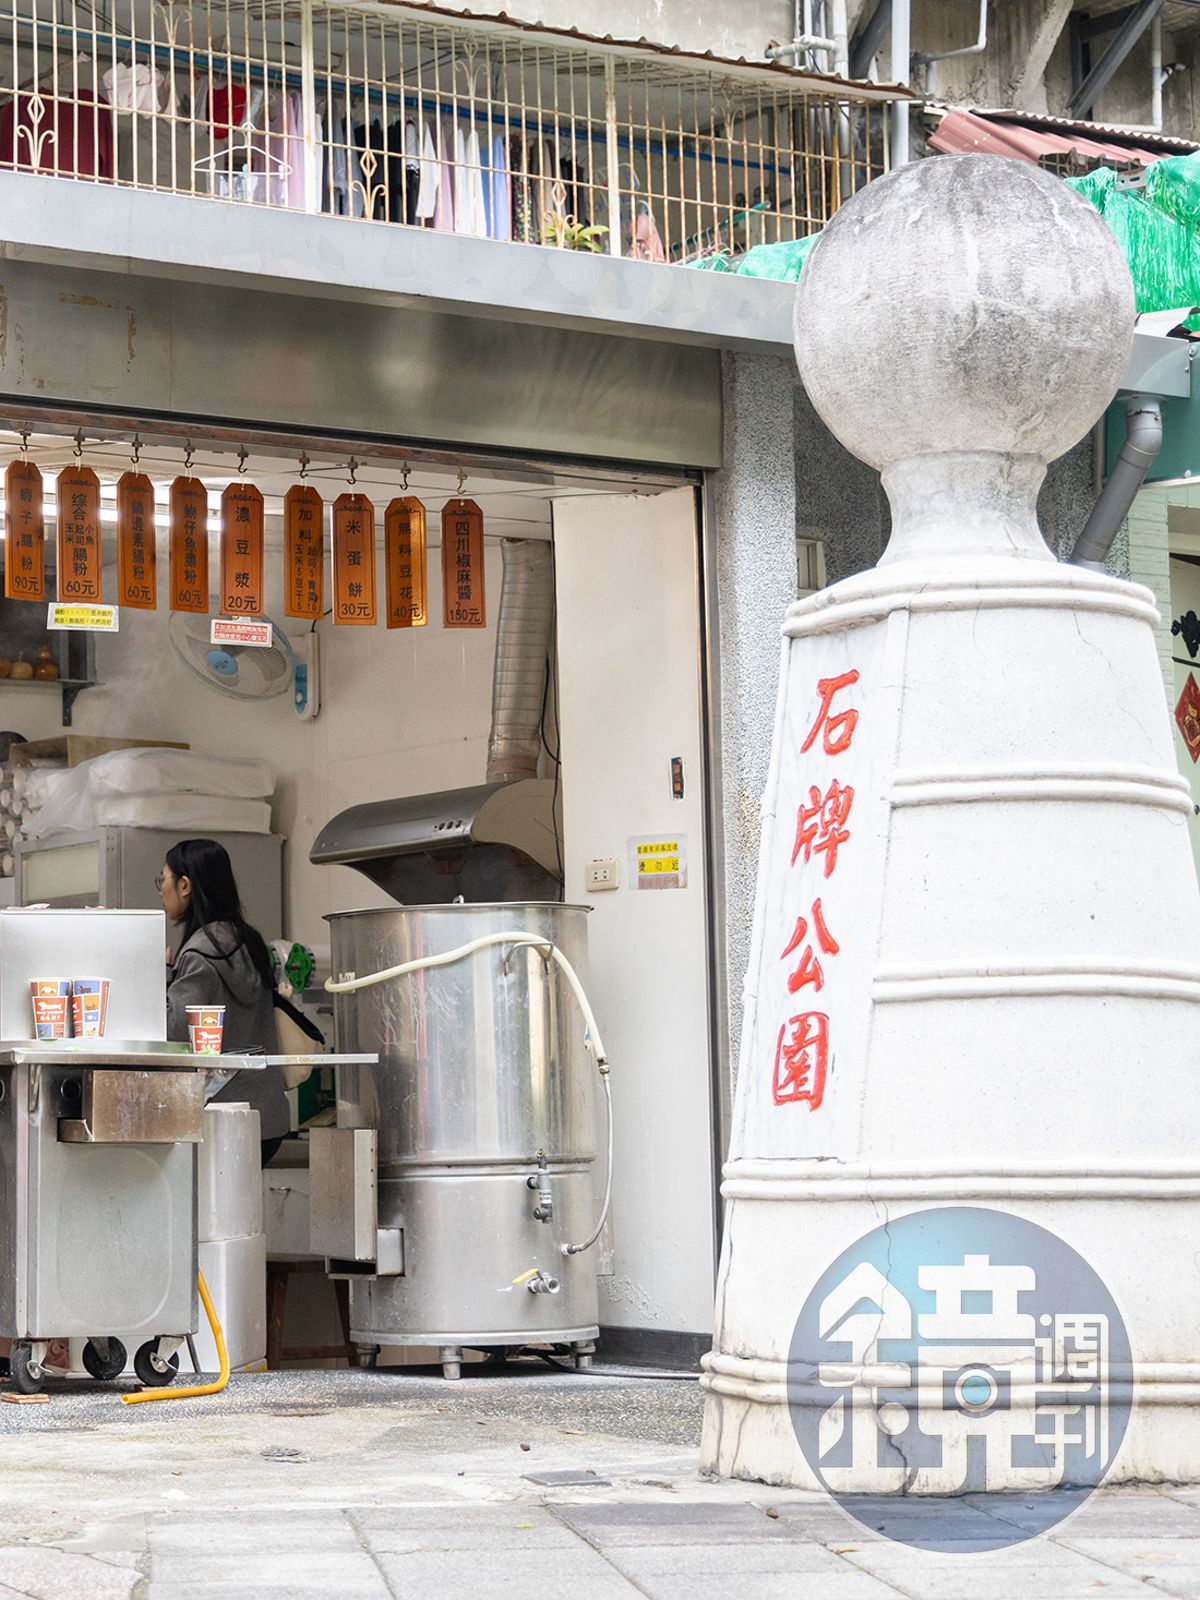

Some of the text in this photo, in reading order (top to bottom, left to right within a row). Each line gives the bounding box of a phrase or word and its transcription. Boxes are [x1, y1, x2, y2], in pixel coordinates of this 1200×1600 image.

[19, 488, 33, 571] 蝦子腸粉
[298, 509, 313, 543] 加料
[234, 507, 250, 588] 濃豆漿
[346, 520, 363, 598] 米蛋餅
[398, 523, 412, 599] 無料豆花
[455, 521, 471, 601] 四川椒麻醬
[73, 548, 87, 576] 腸粉
[14, 576, 39, 592] 90元
[65, 580, 95, 595] 60元
[127, 586, 151, 600] 60元
[178, 589, 203, 604] 60元
[228, 595, 257, 610] 20元
[341, 603, 370, 617] 30元
[394, 603, 423, 618] 40元
[771, 668, 861, 1112] 石牌公園
